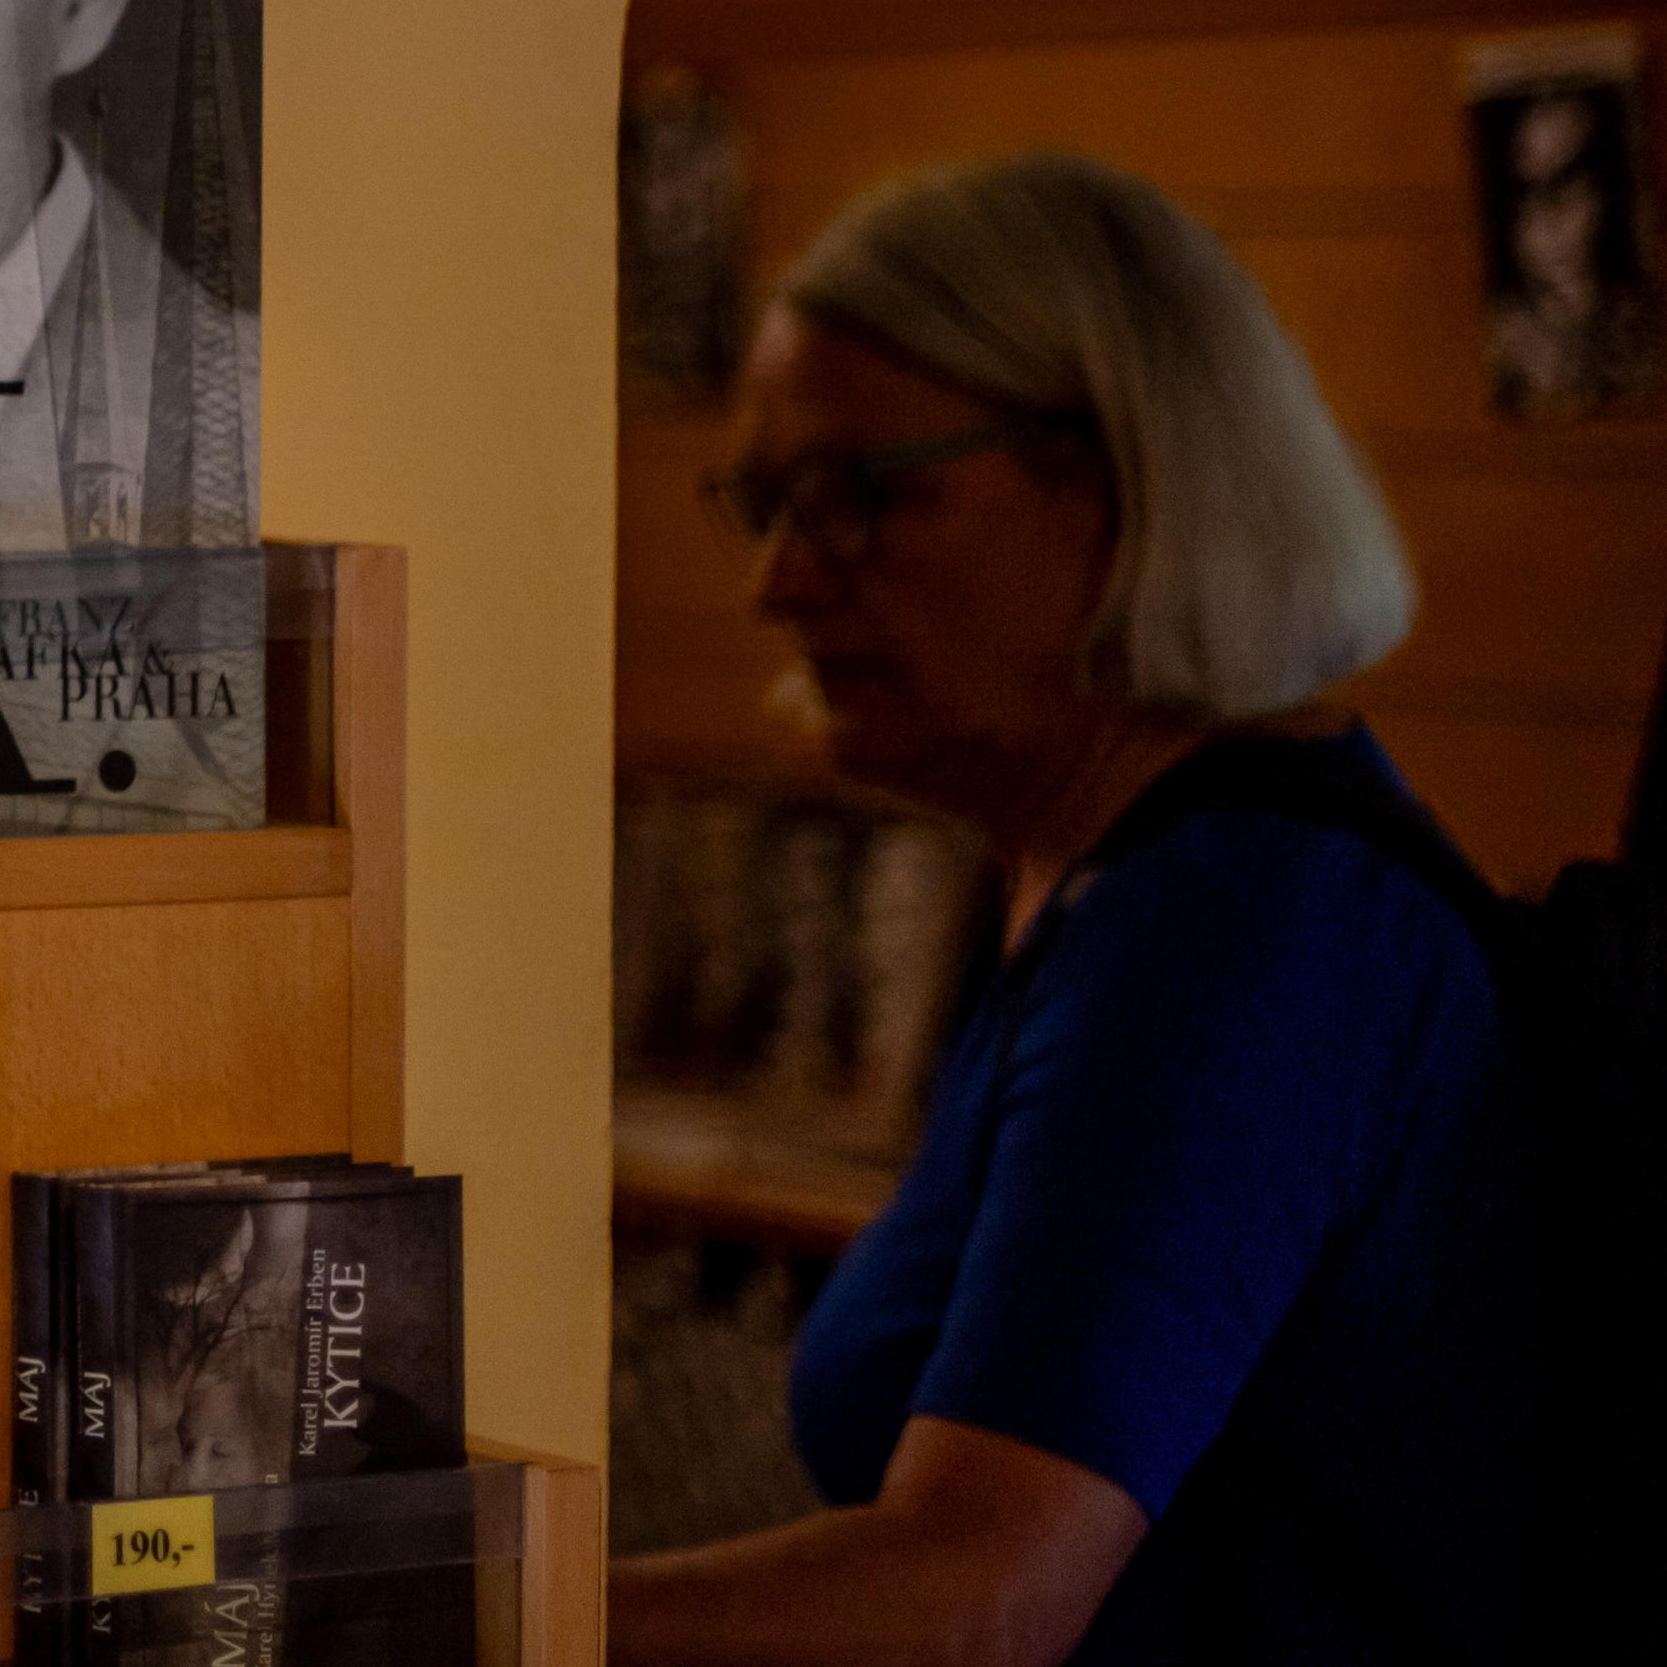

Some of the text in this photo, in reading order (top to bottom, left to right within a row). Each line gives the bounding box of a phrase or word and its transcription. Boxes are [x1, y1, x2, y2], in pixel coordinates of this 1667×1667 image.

[57, 670, 238, 723] PRAHA
[298, 1248, 327, 1457] Karel Jaromír Erben
[323, 1261, 366, 1431] KYTICE
[112, 1528, 195, 1568] 190,-
[203, 1583, 260, 1667] MÁJ
